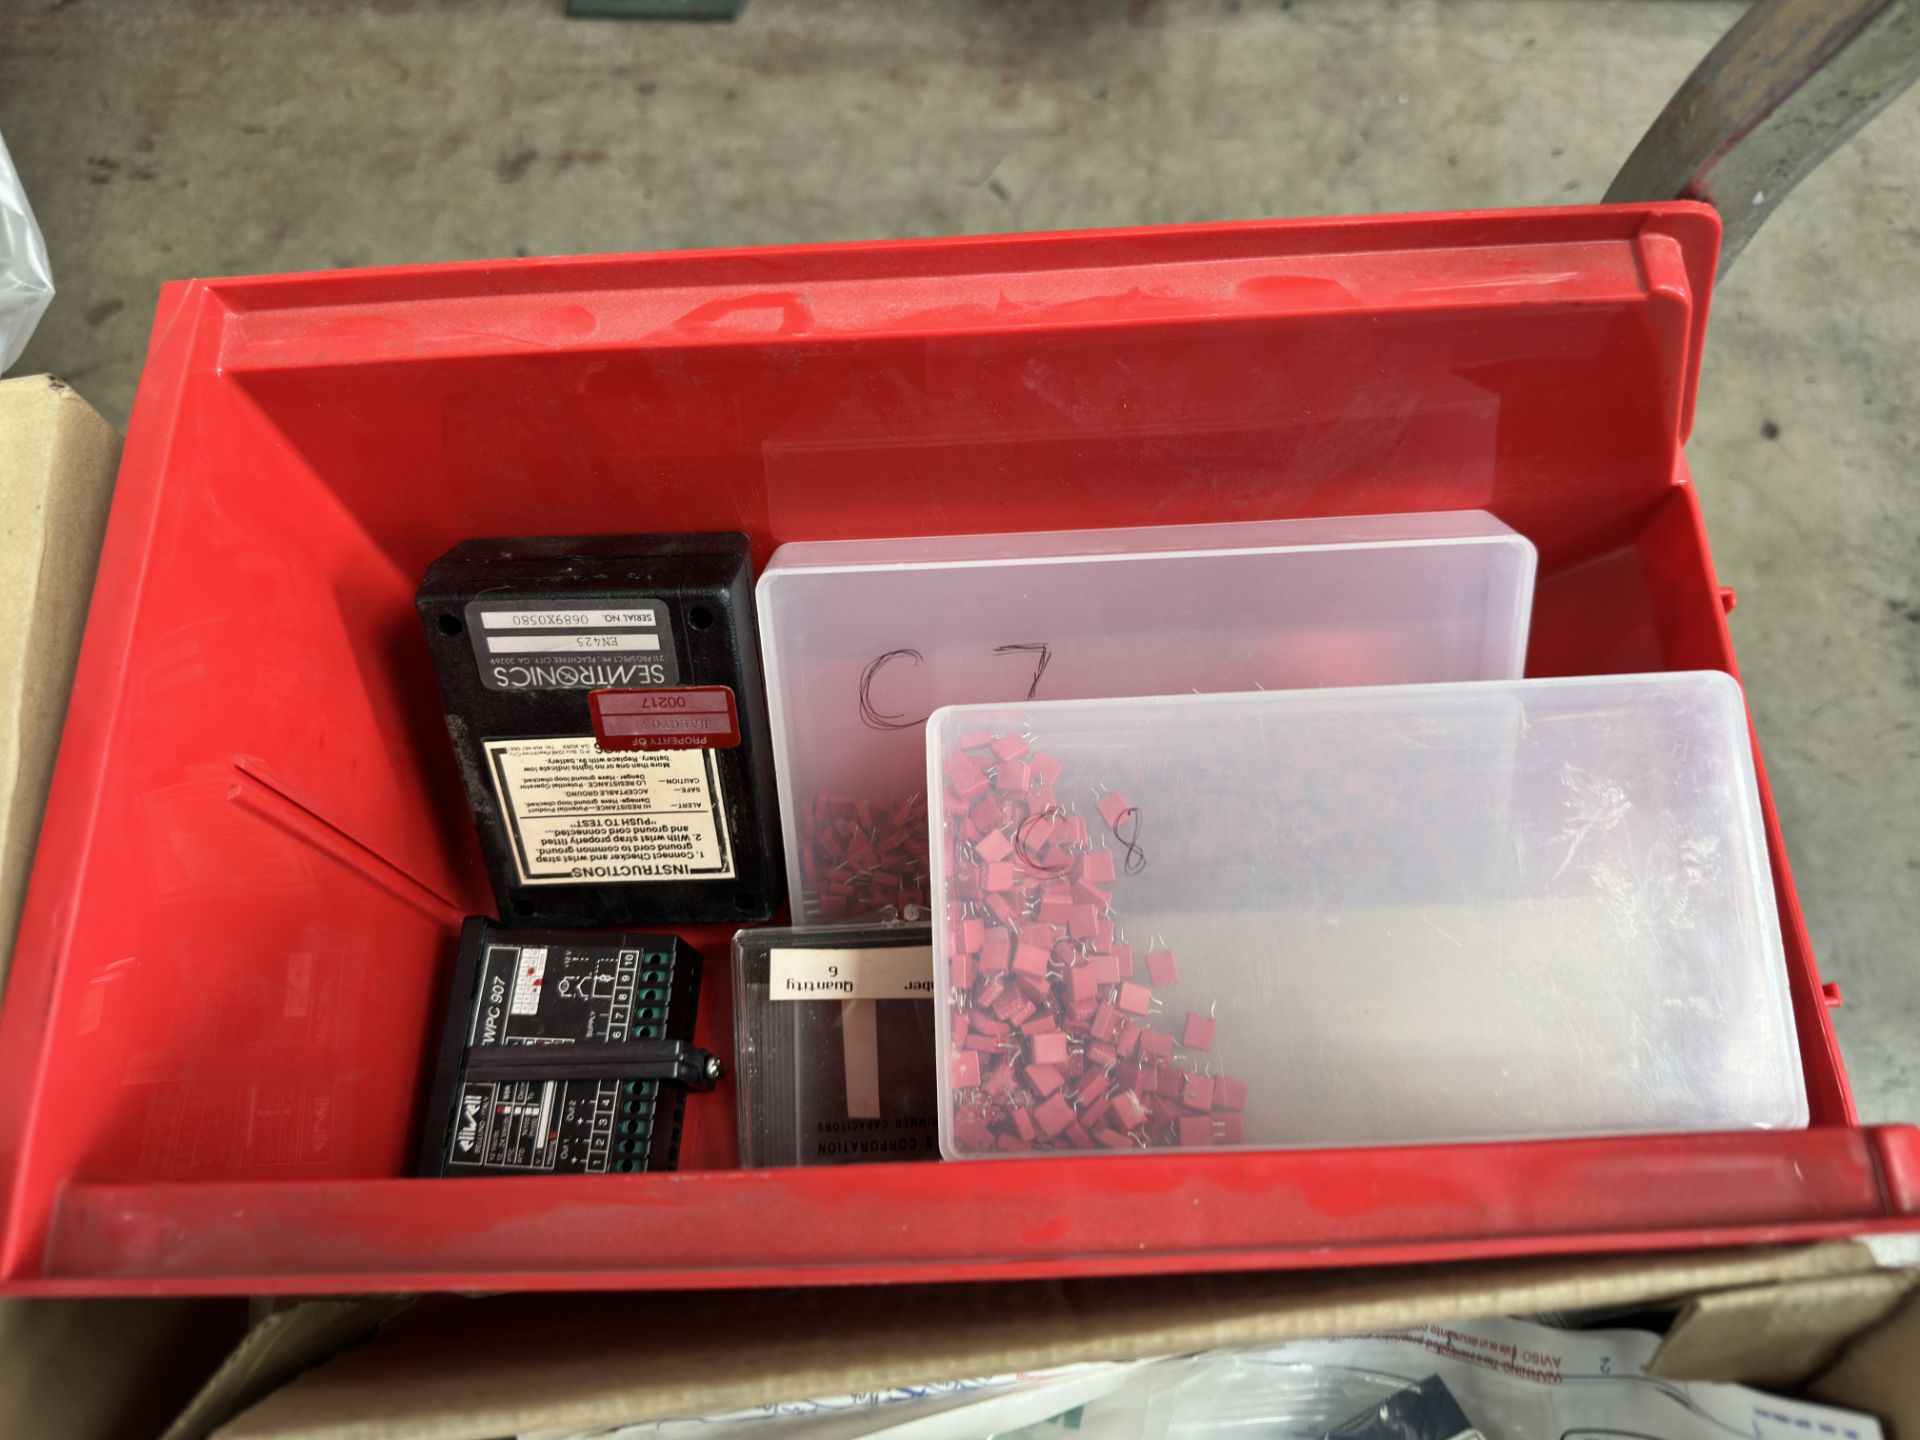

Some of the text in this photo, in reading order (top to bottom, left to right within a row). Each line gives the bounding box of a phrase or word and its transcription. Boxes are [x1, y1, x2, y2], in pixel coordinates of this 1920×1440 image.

[513, 614, 652, 625] SERIAL NO. 0689X0580
[576, 637, 618, 646] EN425
[494, 665, 665, 686] SEMTRONICS
[642, 697, 685, 708] 00217
[632, 737, 707, 746] PROPERTY OF
[607, 756, 637, 764] Replace
[571, 763, 593, 771] lights
[608, 828, 631, 836] cord
[634, 824, 668, 834] ground
[541, 838, 568, 846] fitted
[570, 835, 610, 844] properly
[613, 834, 638, 843] strap
[667, 834, 690, 842] With
[536, 845, 574, 856] ground.
[576, 846, 619, 854] common
[634, 844, 656, 852] cord
[658, 842, 693, 850] ground
[535, 855, 561, 864] strap
[563, 855, 587, 863] wrist
[590, 854, 608, 862] and
[610, 853, 650, 861] Checker
[652, 851, 694, 860] Connect
[571, 864, 689, 878] INSTRUCTIONS
[624, 954, 634, 966] 10
[828, 966, 838, 976] 6
[490, 976, 507, 1004] 907
[786, 978, 853, 993] Quantity
[585, 1010, 596, 1038] SUPPLY
[458, 1094, 482, 1152] eliwell
[599, 1118, 608, 1126] 3
[817, 1119, 888, 1133] CAPACITORS
[818, 1139, 917, 1154] CORPORATION
[1523, 1350, 1561, 1368] AVISO
